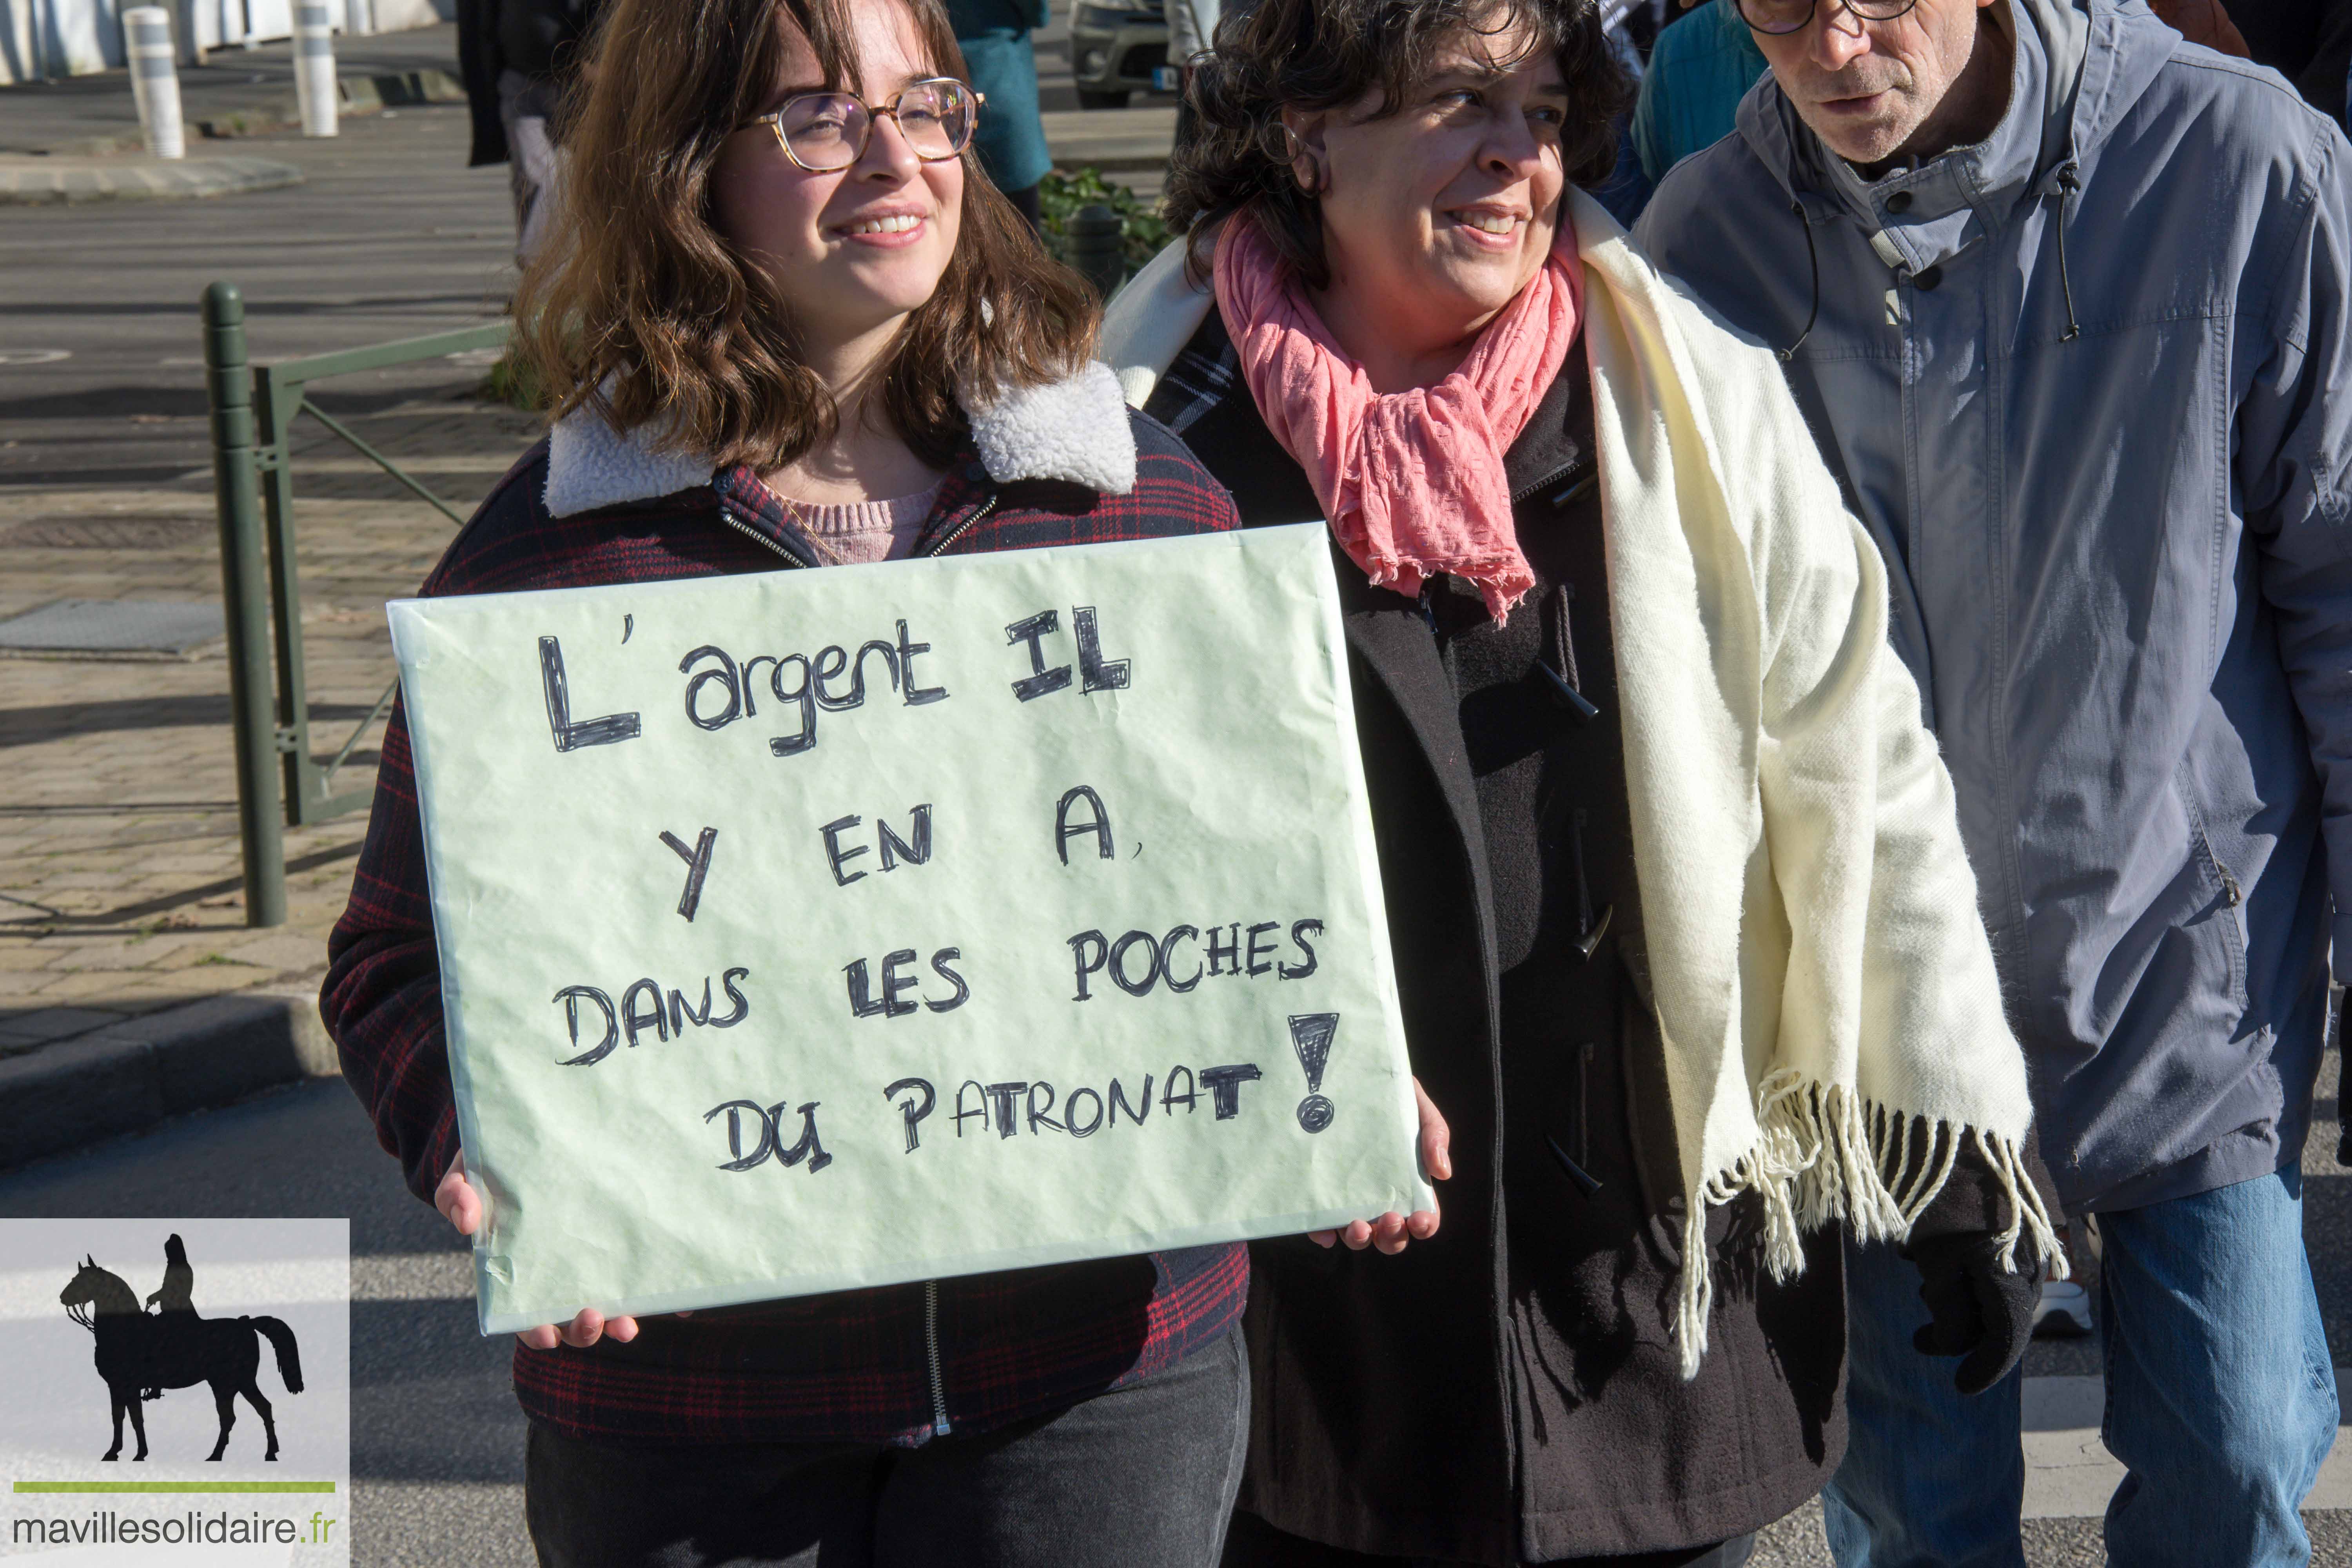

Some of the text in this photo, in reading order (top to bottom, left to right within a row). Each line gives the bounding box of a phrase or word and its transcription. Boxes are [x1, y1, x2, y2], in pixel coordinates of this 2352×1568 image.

[1006, 606, 1131, 702] IL
[659, 827, 717, 922] Y
[819, 804, 932, 886] EN
[553, 919, 1325, 1067] DANS LES POCHES
[704, 1100, 832, 1174] DU
